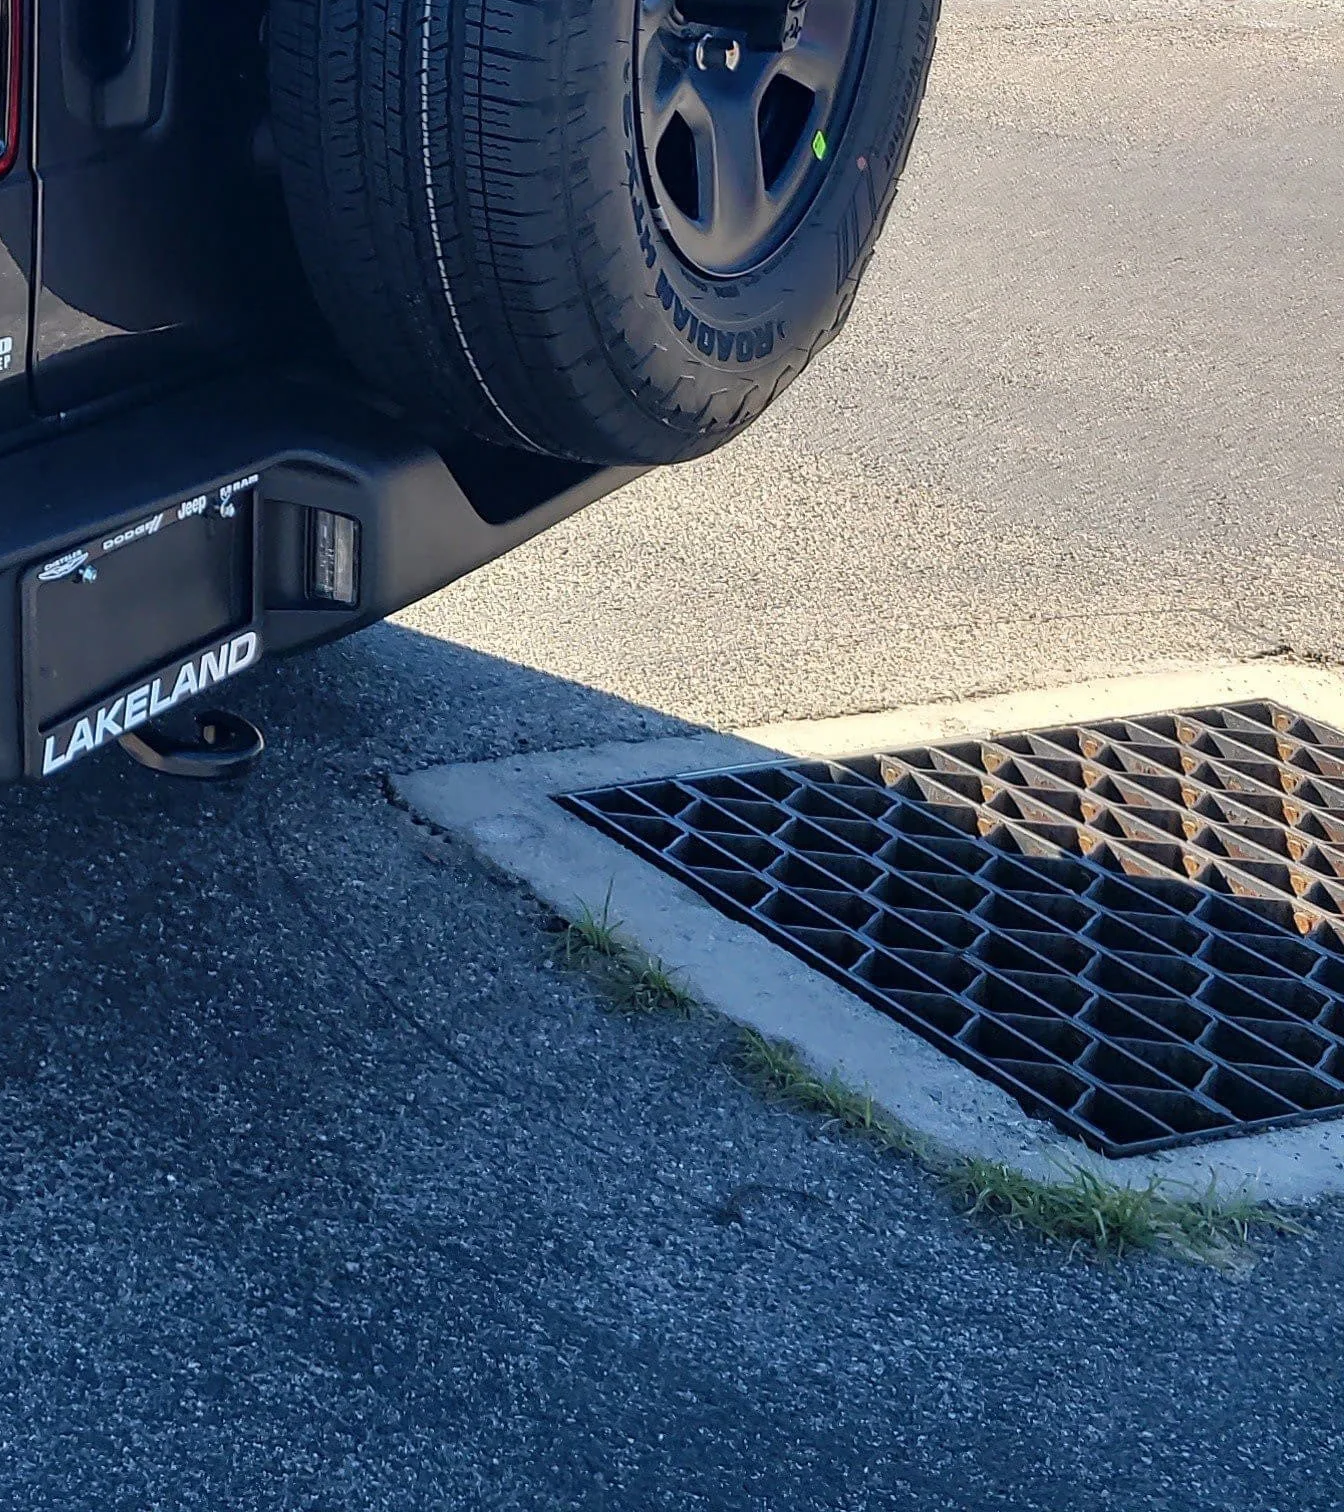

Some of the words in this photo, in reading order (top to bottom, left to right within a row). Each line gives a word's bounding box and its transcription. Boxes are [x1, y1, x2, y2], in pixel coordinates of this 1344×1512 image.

[654, 267, 777, 363] ROADIAN
[177, 494, 207, 521] Jeep
[232, 473, 260, 492] RAM
[42, 630, 257, 776] LAKELAND
